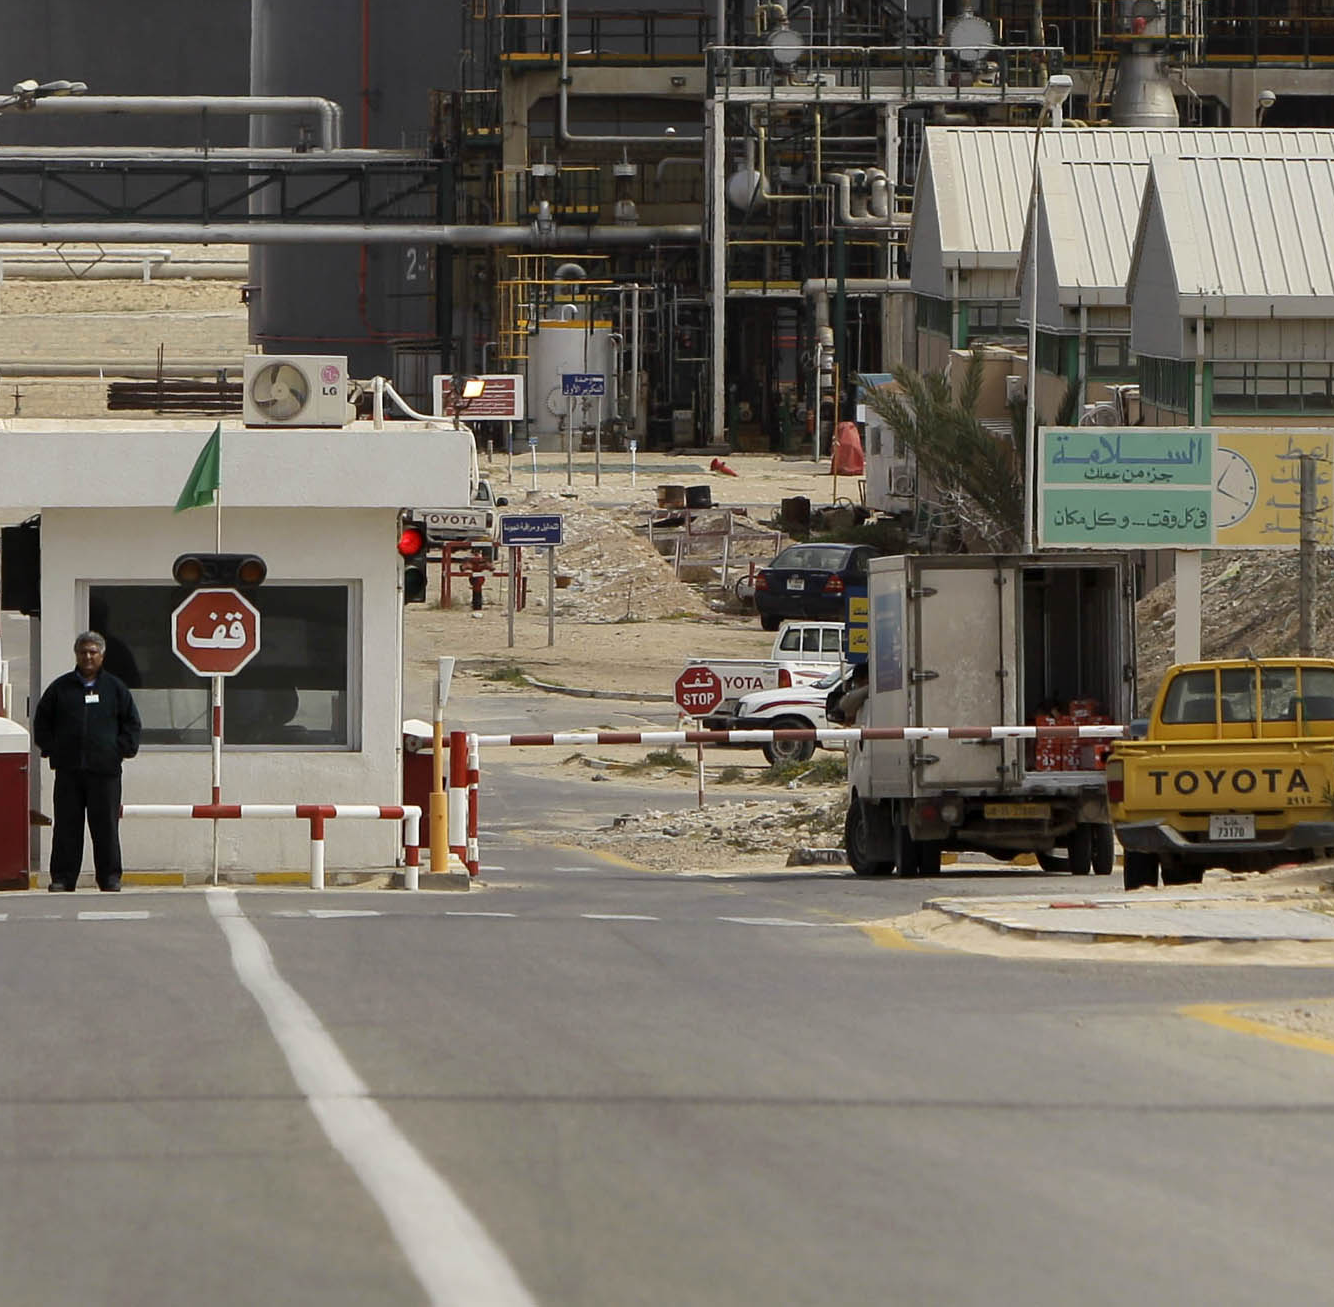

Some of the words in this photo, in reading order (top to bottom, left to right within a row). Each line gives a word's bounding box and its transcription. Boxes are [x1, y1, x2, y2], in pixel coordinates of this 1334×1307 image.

[322, 386, 337, 396] LG
[1052, 435, 1203, 465] السلامة
[1122, 469, 1145, 483] من
[186, 612, 247, 649] قف
[681, 671, 714, 689] قف
[723, 676, 764, 690] YOTA
[682, 692, 715, 707] STOP
[1148, 768, 1311, 795] TOYOTA
